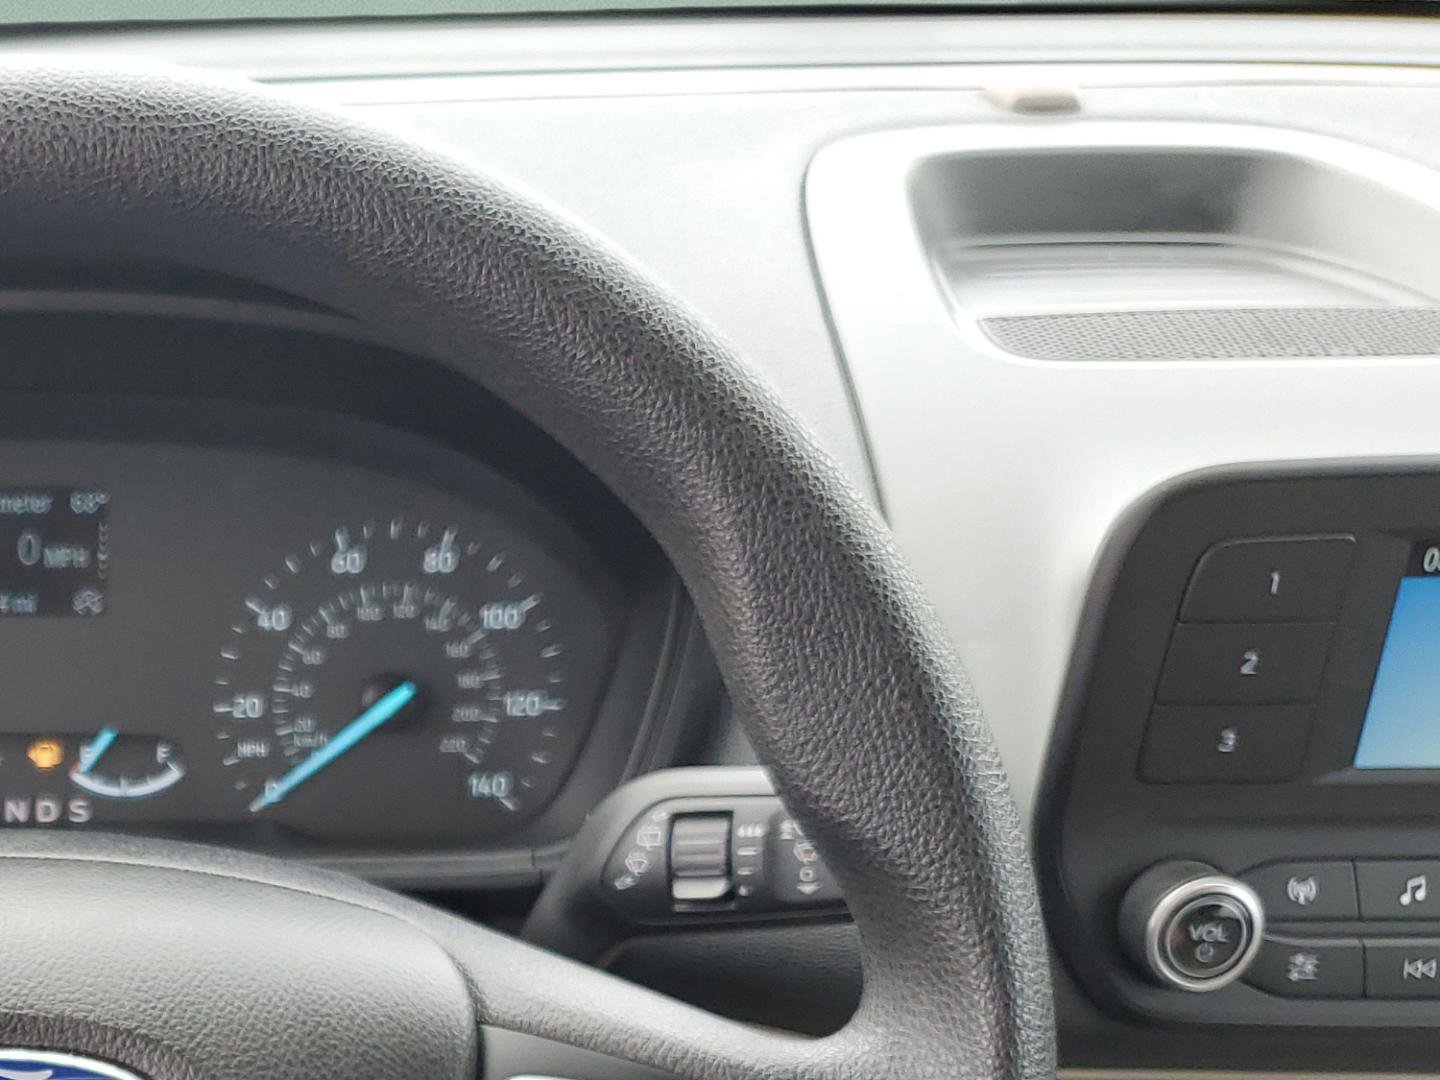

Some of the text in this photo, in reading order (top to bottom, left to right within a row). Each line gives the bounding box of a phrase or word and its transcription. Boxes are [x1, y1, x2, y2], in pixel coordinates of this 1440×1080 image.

[17, 530, 42, 567] 0
[330, 545, 368, 574] 60
[423, 545, 460, 574] 80
[1269, 570, 1280, 595] 1
[257, 603, 292, 631] 40
[479, 602, 525, 630] 100
[1239, 650, 1260, 675] 2
[232, 692, 264, 718] 20
[1217, 727, 1240, 753] 3
[5, 796, 30, 823] N
[35, 796, 60, 823] D
[68, 796, 92, 823] S
[1188, 922, 1229, 944] VOL
